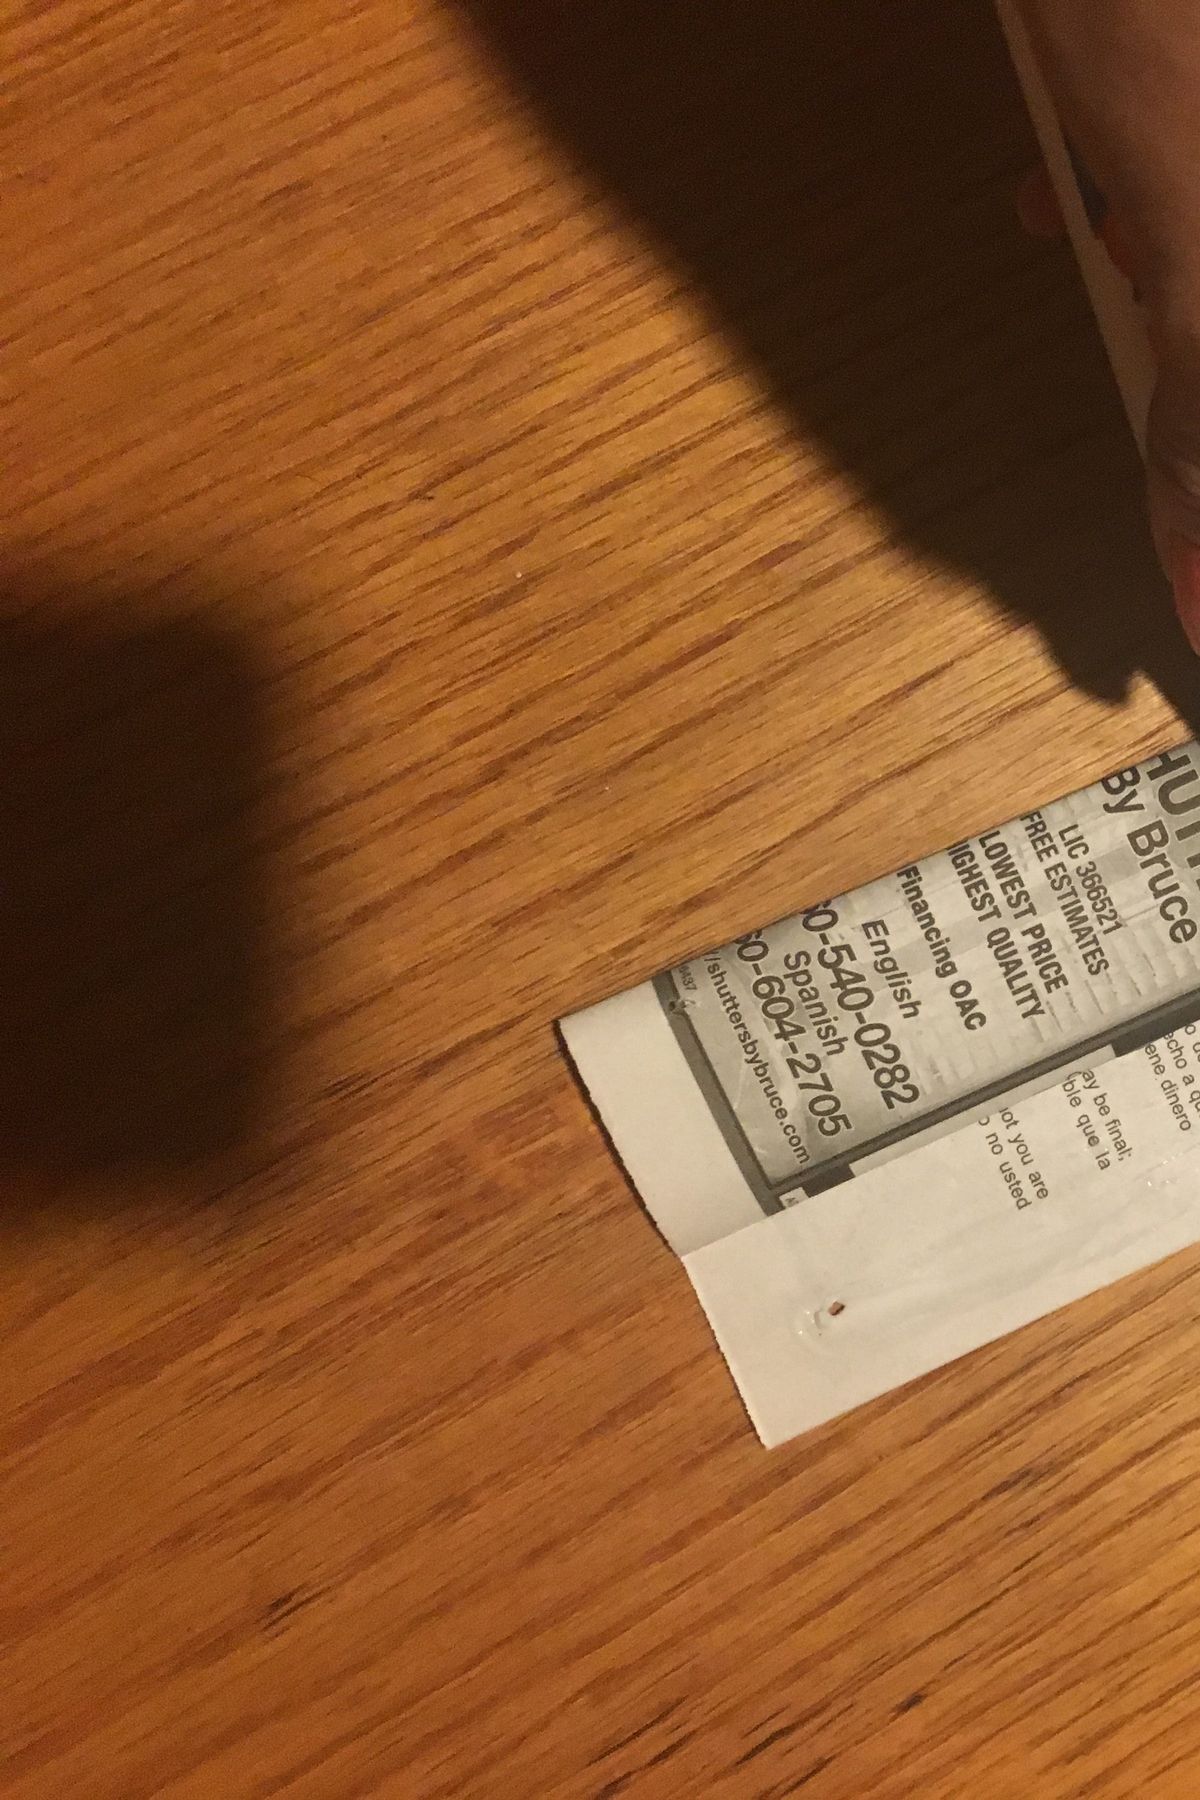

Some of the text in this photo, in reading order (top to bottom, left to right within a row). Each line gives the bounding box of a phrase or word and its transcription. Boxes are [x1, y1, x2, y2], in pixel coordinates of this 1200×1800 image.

[1016, 807, 1110, 976] FREE ESTIMATES
[1058, 823, 1123, 935] LIC 366521
[1097, 763, 1198, 944] By Bruce
[895, 864, 987, 1031] Financing OAC
[977, 829, 1069, 994] LOWEST PRICE
[782, 949, 849, 1056] Spanish
[860, 918, 922, 1019] English
[986, 926, 1045, 1019] QUALITY
[1092, 1091, 1111, 1117] be
[1104, 1118, 1133, 1161] final;
[1160, 1078, 1192, 1131] dinero
[1182, 1073, 1195, 1087] a
[985, 1132, 1003, 1155] no
[998, 1161, 1032, 1210] usted
[1007, 1132, 1034, 1166] you
[1028, 1170, 1049, 1200] are
[1076, 1114, 1100, 1147] que
[1094, 1150, 1111, 1171] la
